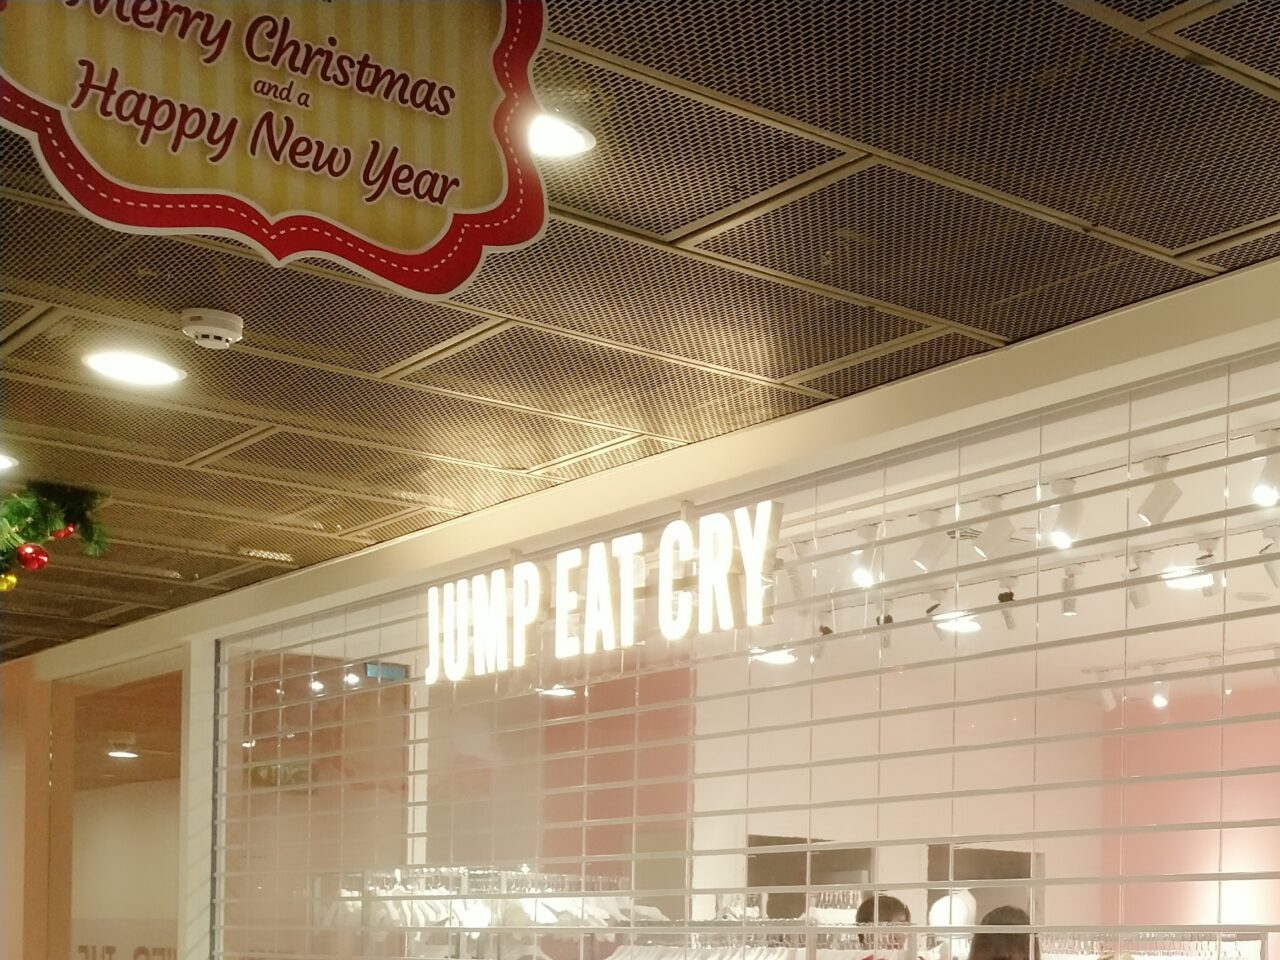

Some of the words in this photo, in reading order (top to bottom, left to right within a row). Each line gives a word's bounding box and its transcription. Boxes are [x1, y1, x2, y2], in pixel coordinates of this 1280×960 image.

[245, 15, 456, 115] Christmas
[253, 78, 293, 103] and
[297, 91, 310, 107] a
[72, 60, 238, 161] Happy
[249, 111, 351, 177] New
[361, 140, 460, 205] Year
[425, 561, 541, 685] JUMP
[555, 532, 643, 659] EAT
[658, 500, 773, 640] CRY
